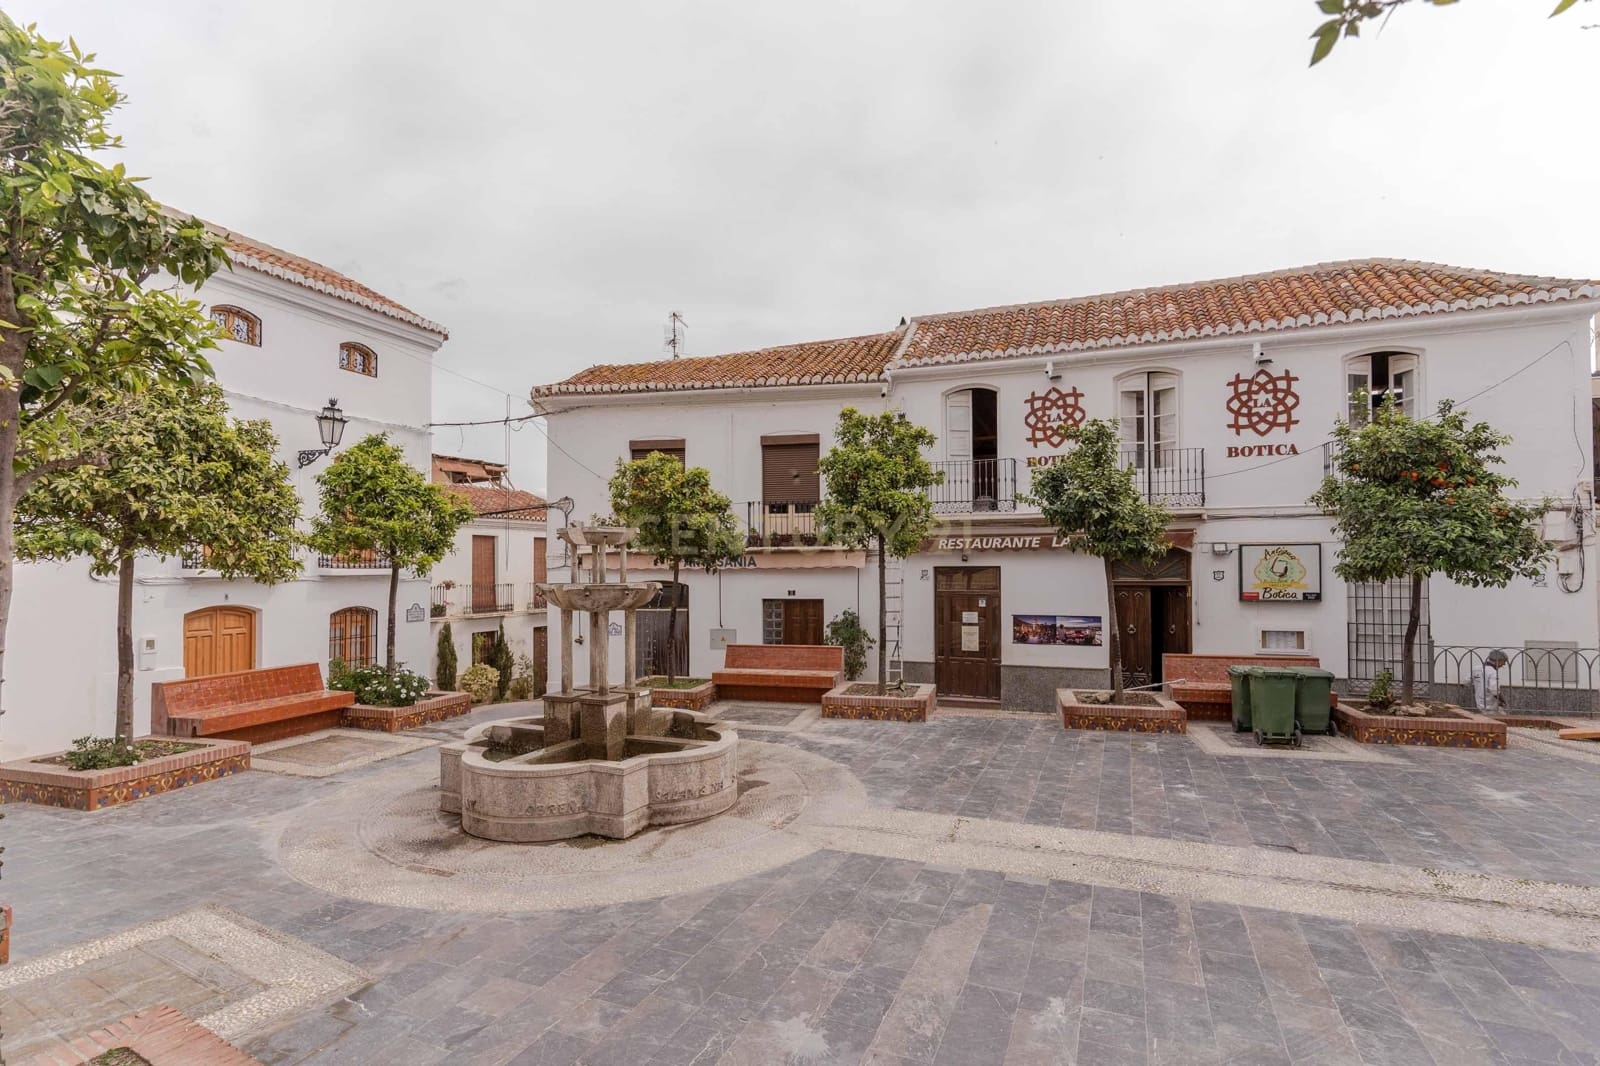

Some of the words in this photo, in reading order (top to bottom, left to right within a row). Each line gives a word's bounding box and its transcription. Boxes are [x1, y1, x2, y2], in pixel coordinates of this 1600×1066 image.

[1252, 398, 1272, 408] LA
[1047, 412, 1063, 423] LA
[1227, 443, 1300, 458] BOTICA
[938, 536, 1041, 551] RESTAURANTE
[1051, 536, 1071, 550] LA
[1262, 587, 1298, 599] Botica
